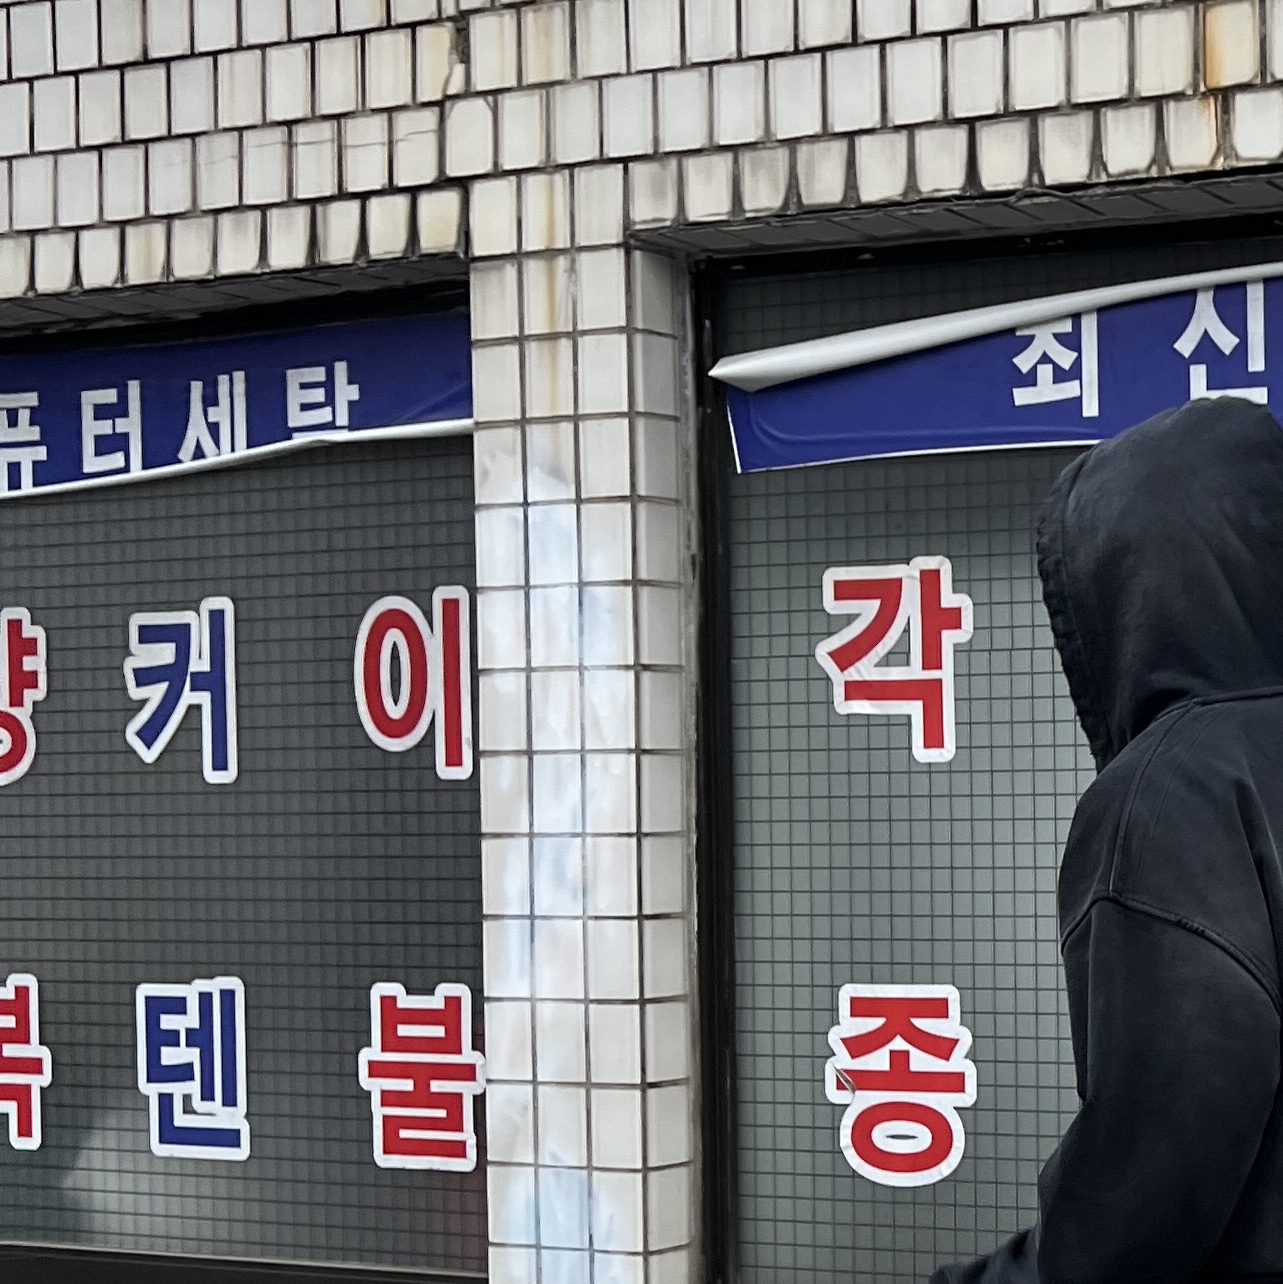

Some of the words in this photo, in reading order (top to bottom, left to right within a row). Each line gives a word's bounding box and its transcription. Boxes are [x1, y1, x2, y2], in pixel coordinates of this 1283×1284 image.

[124, 597, 250, 1161] 커텐
[354, 585, 486, 1172] 이불
[815, 555, 977, 1187] 각종
